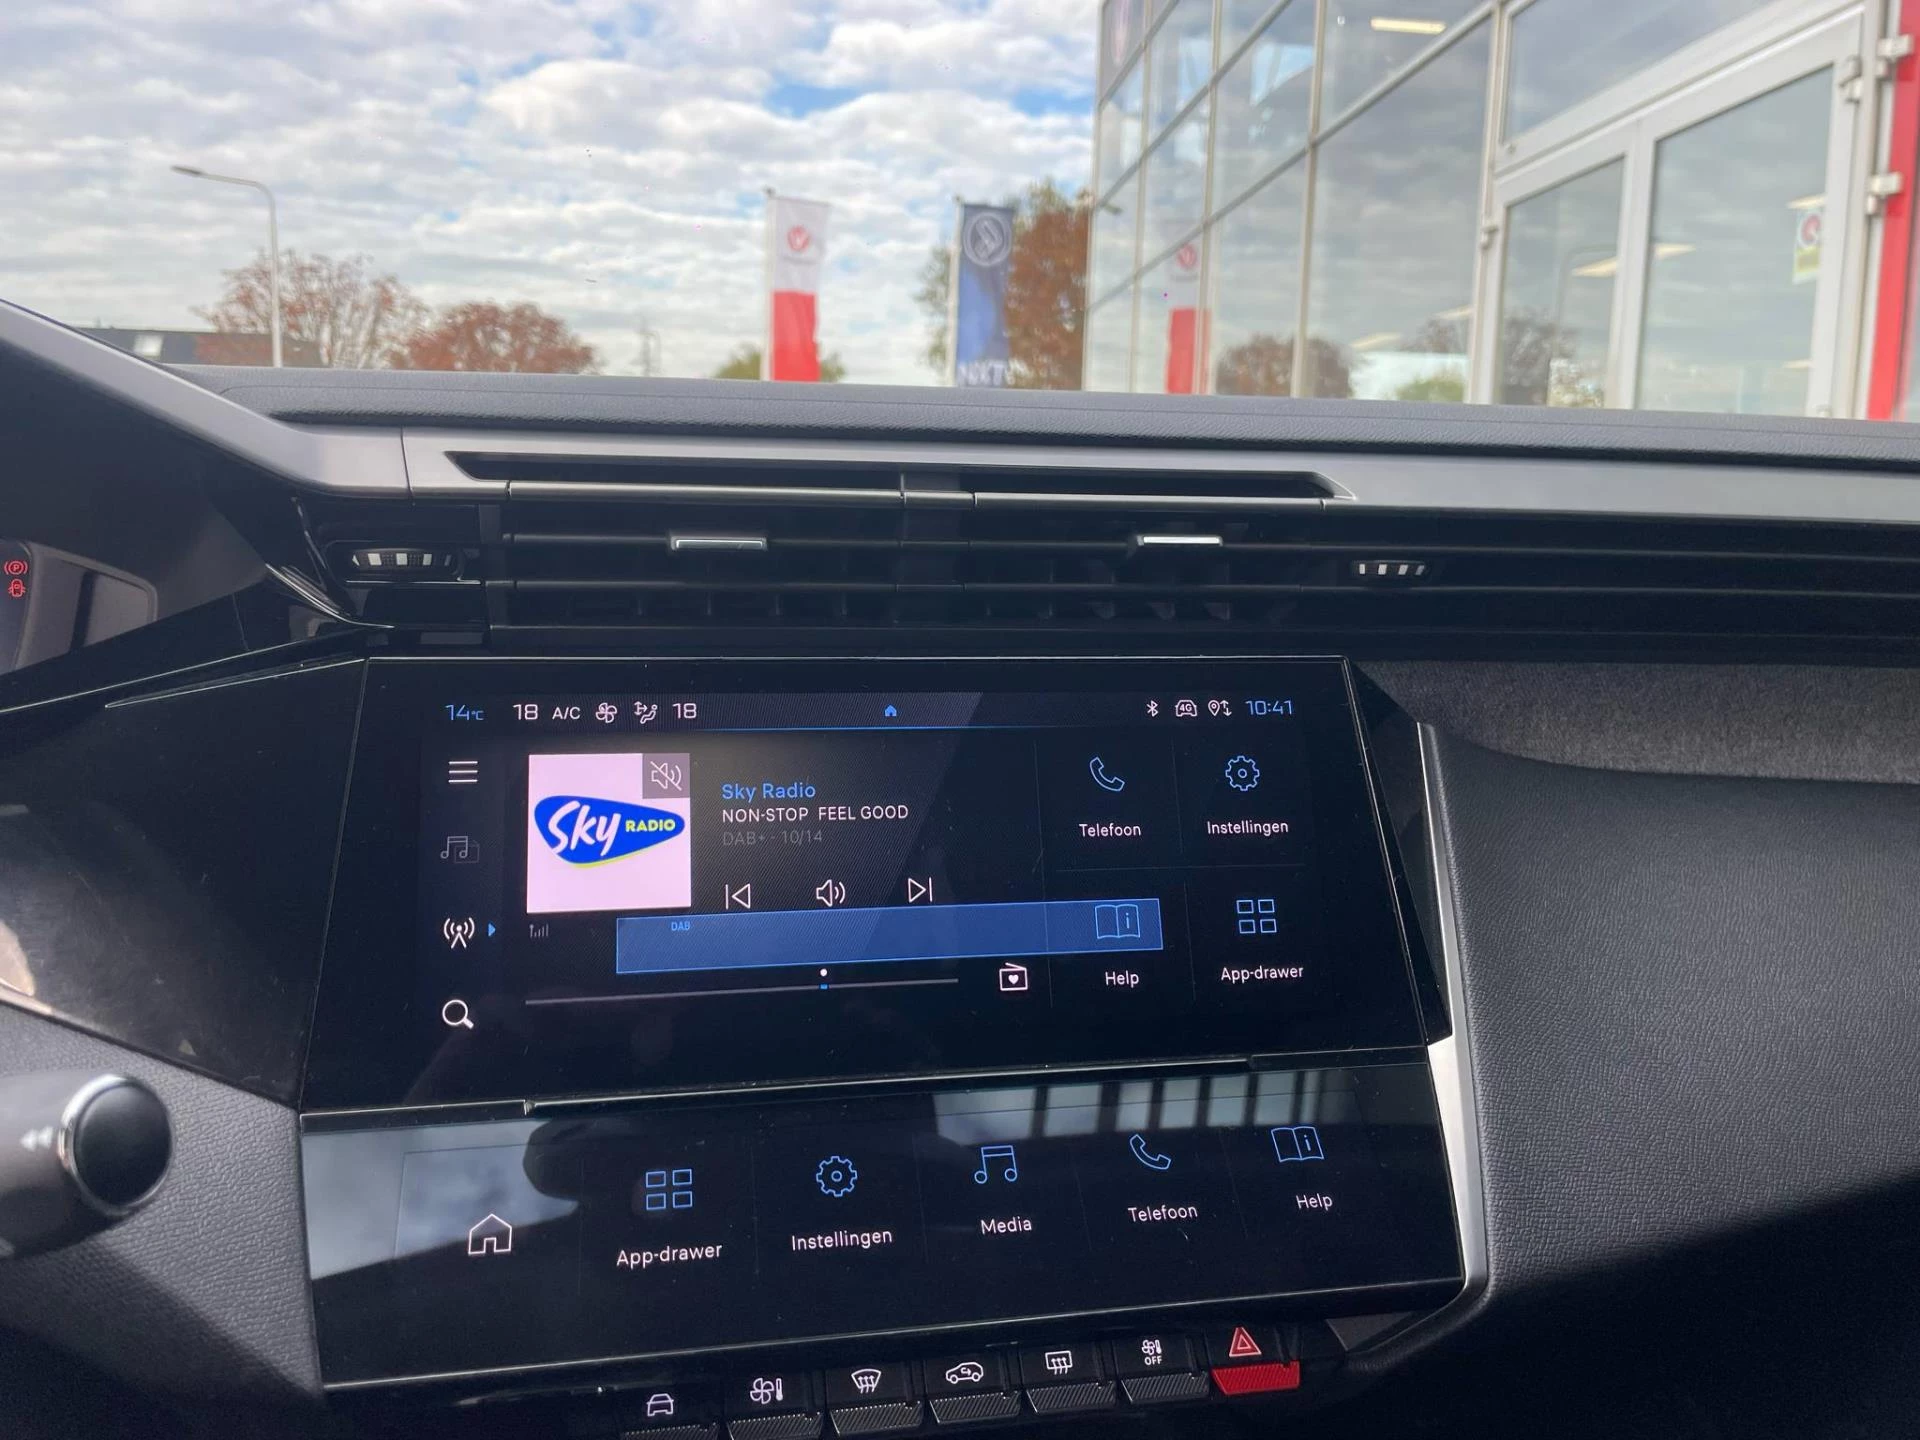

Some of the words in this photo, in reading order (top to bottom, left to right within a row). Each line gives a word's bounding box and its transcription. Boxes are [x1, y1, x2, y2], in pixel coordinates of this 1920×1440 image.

[513, 703, 539, 720] 18
[552, 706, 581, 720] A/C
[672, 702, 697, 719] 18
[1179, 703, 1193, 713] 4G
[1245, 700, 1293, 716] 10:41
[722, 783, 756, 803] Sky
[762, 782, 816, 799] Radio
[722, 807, 809, 824] NON-STOP
[818, 806, 857, 821] FEEL
[860, 804, 909, 820] GOOD
[547, 800, 622, 857] Sky
[625, 819, 676, 832] RADIO
[1078, 822, 1142, 838] Telefoon
[1206, 819, 1289, 837] Instellingen
[722, 831, 765, 846] DAB+
[781, 830, 824, 845] 10/14
[671, 920, 691, 932] DAB
[1104, 970, 1140, 988] Help
[1220, 964, 1304, 984] App-drawer
[1295, 1193, 1333, 1211] Help
[1127, 1204, 1198, 1223] Telefoon
[980, 1216, 1032, 1235] Media
[791, 1230, 893, 1252] Instellingen
[616, 1243, 723, 1270] App-drawer
[1144, 1355, 1162, 1366] OFF
